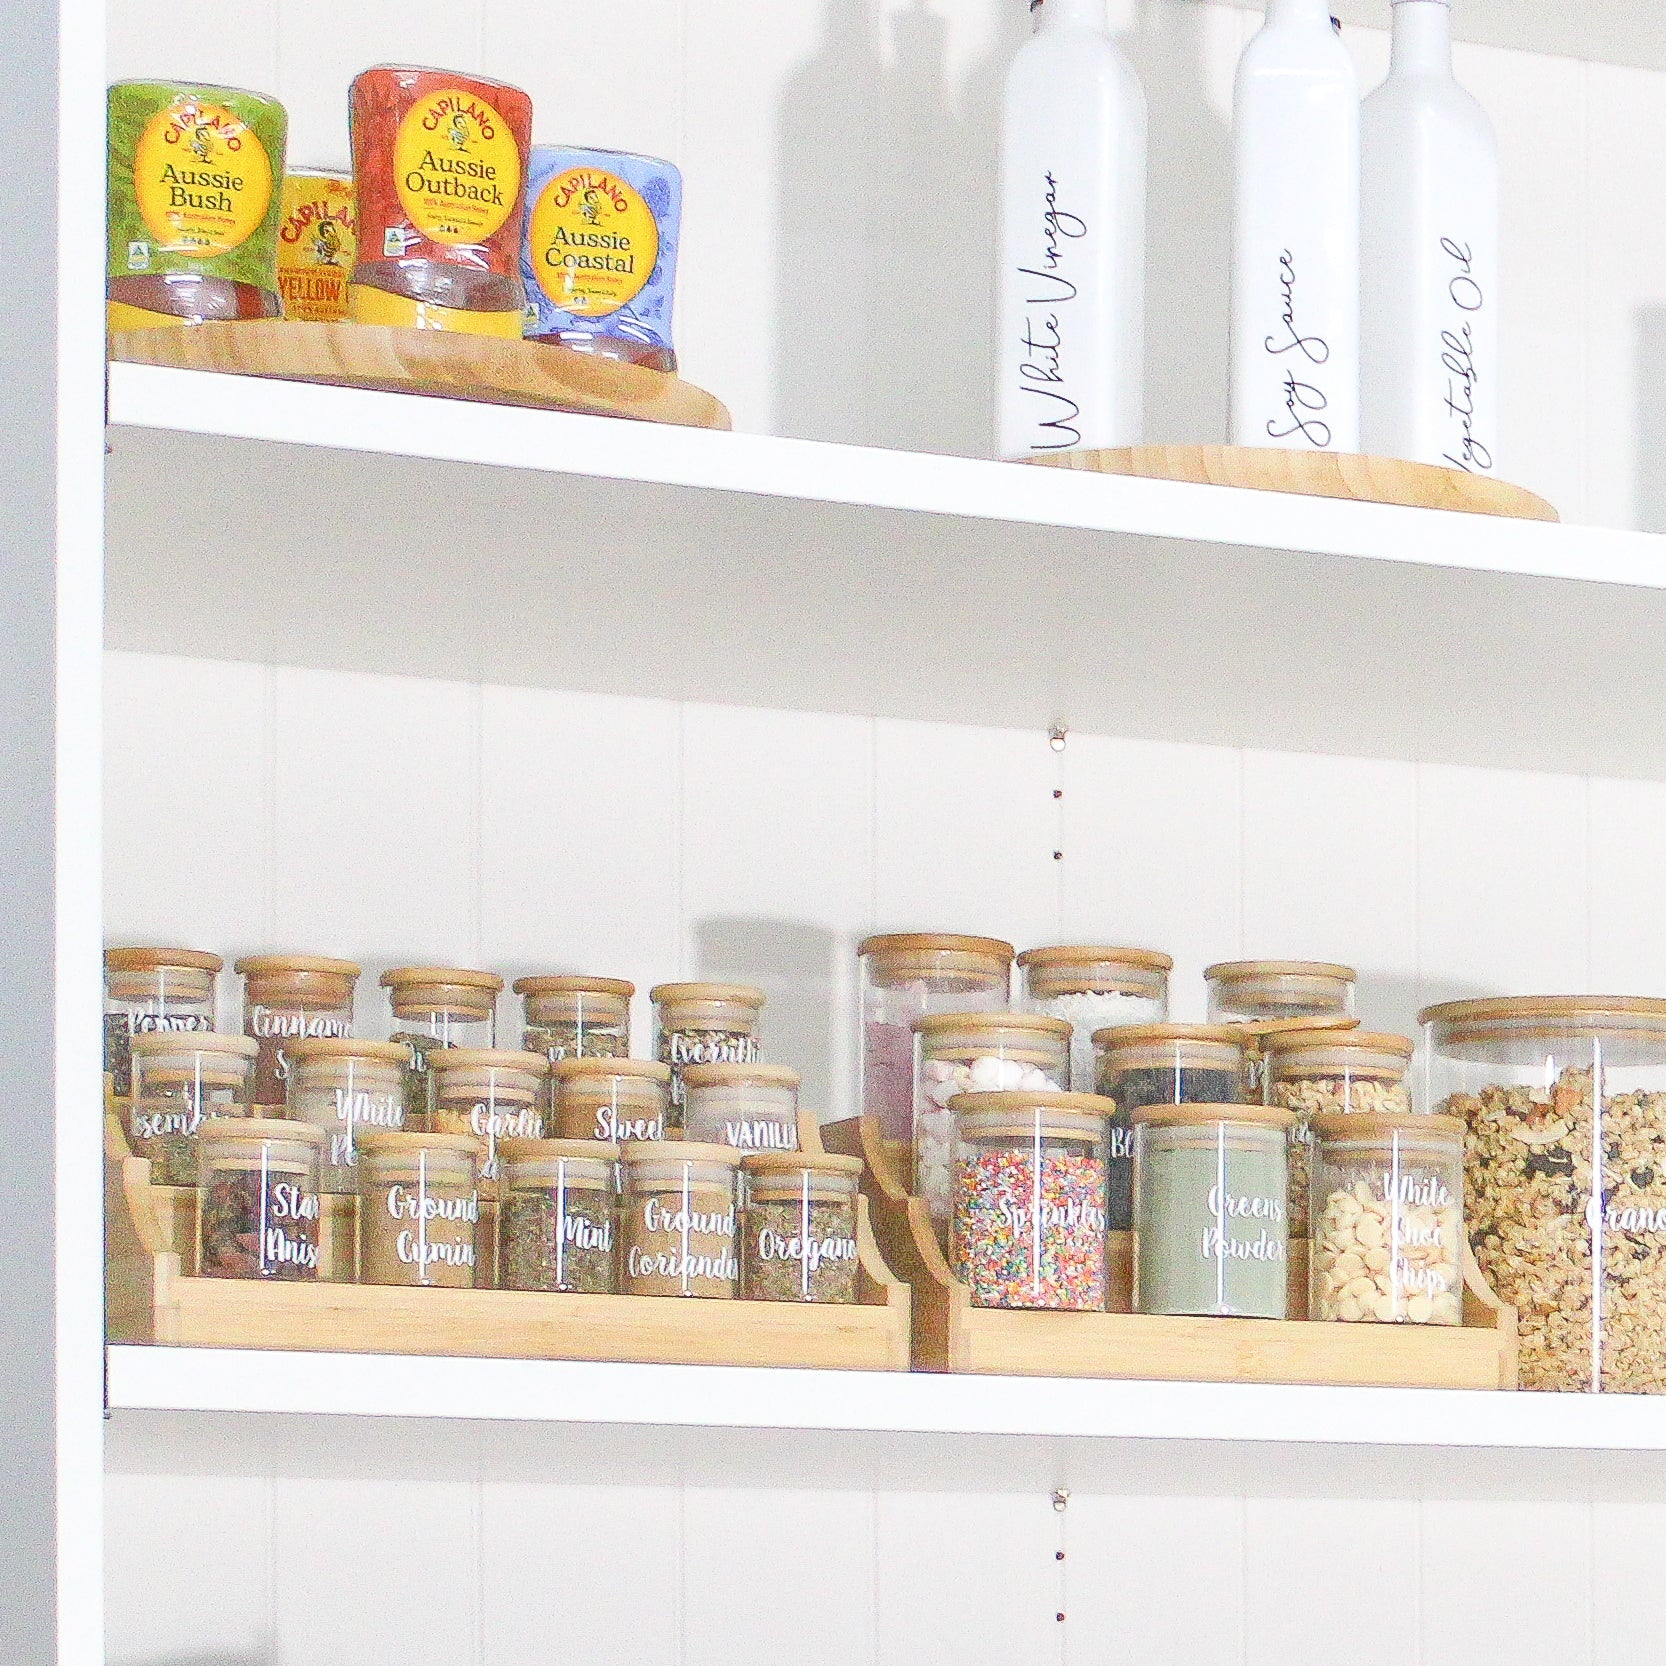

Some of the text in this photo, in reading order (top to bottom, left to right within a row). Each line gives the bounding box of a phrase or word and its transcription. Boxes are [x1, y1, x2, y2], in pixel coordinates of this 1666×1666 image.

[421, 95, 495, 141] CAPILANO
[159, 163, 244, 192] Aussie
[418, 149, 497, 181] Aussie
[168, 186, 233, 213] Bush
[404, 170, 505, 207] Outback
[553, 173, 629, 213] CAPILANO
[550, 225, 632, 251] Aussie
[545, 247, 635, 275] Coastal
[1439, 236, 1483, 311] Oil
[278, 275, 341, 302] YELLOW
[1016, 170, 1088, 450] White Vinegar
[1264, 247, 1332, 448] Soy Sauce
[387, 1184, 479, 1223] Ground
[643, 1197, 737, 1238] Ground
[562, 1212, 614, 1253] Mint
